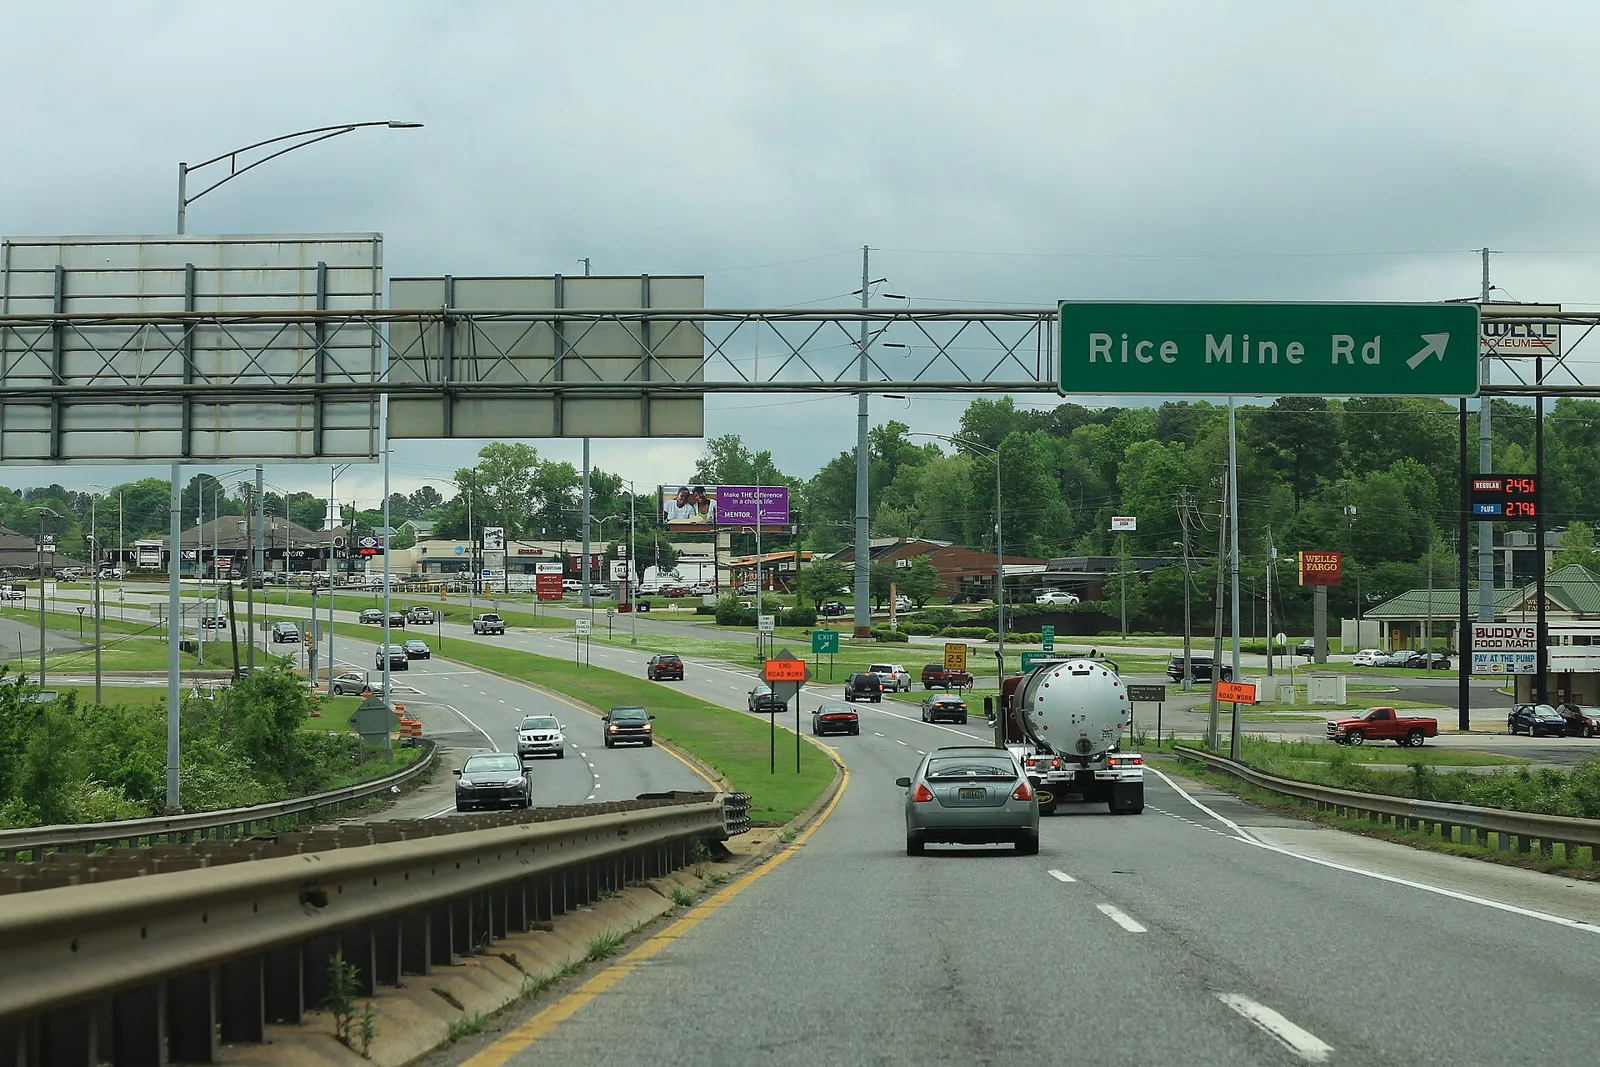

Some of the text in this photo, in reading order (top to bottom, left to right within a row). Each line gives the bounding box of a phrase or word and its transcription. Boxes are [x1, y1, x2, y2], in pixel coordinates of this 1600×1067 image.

[1088, 332, 1381, 365] Rice Mine Rd
[1475, 481, 1500, 489] REGULAR
[1480, 505, 1495, 513] PLUS
[1475, 628, 1535, 638] BUDDY'S
[1474, 640, 1536, 648] FOOD MART
[948, 654, 962, 664] 25
[1474, 654, 1535, 662] PAY AT THE PUMP
